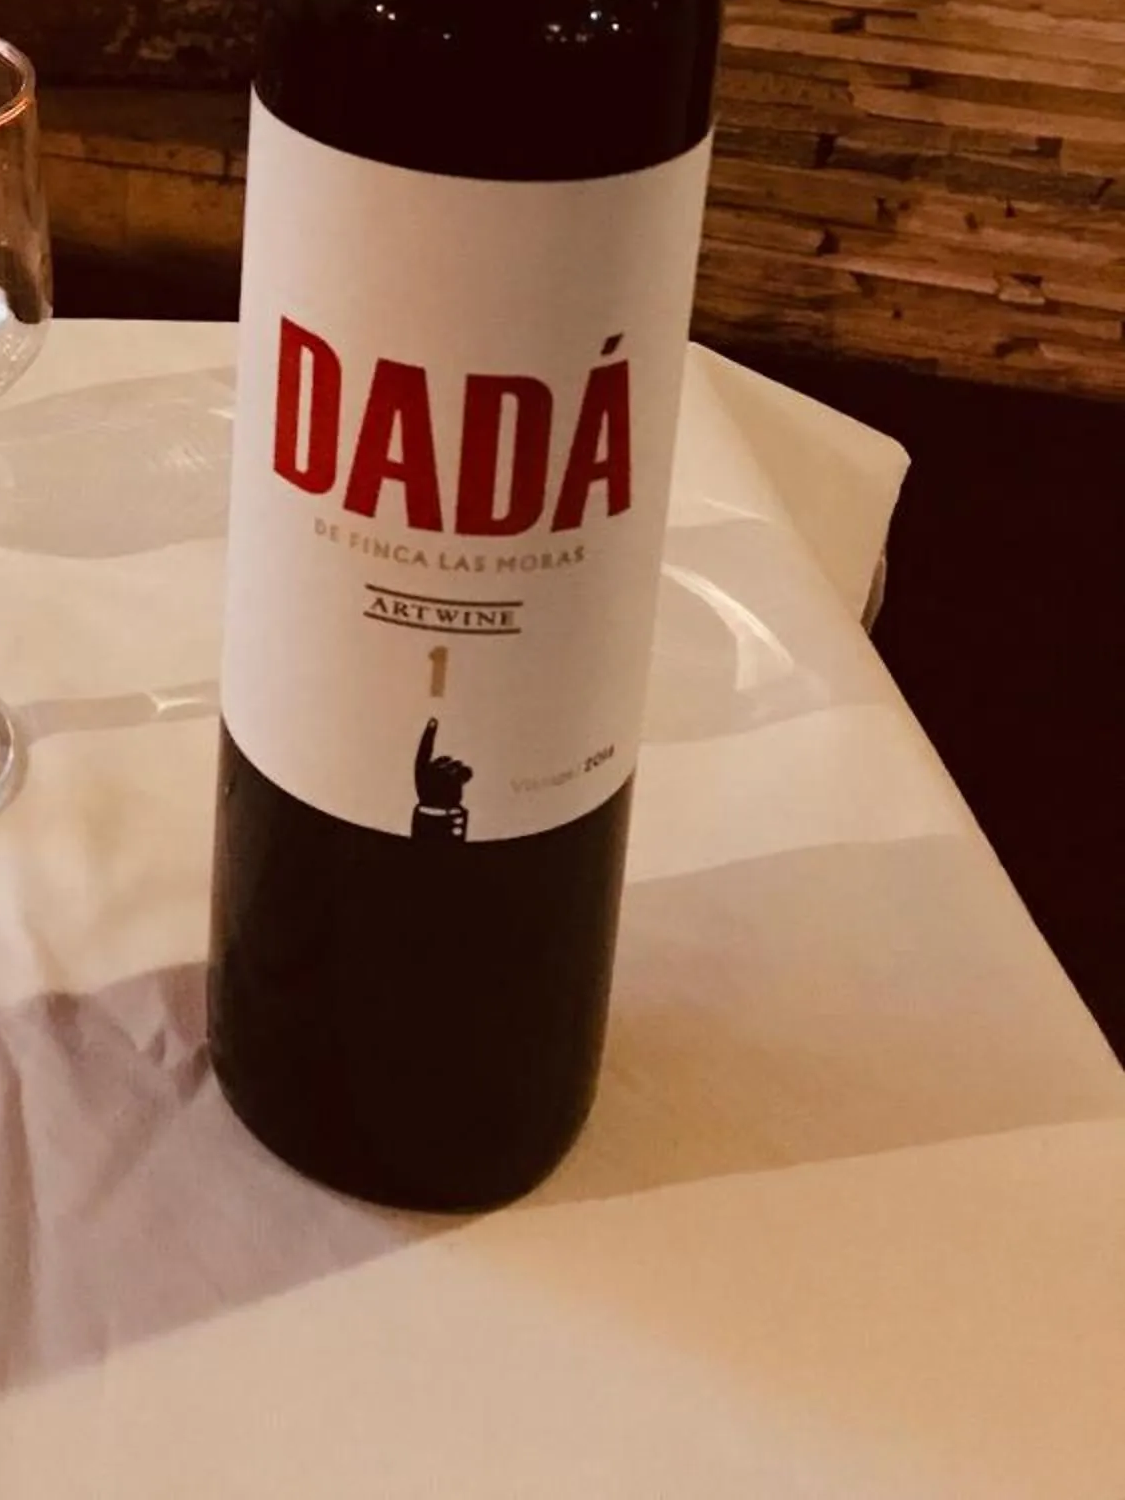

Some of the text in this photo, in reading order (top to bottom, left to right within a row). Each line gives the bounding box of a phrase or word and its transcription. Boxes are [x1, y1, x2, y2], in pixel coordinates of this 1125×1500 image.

[275, 315, 632, 537] DADÁ
[314, 518, 585, 573] DE FINCA LAS MORAS
[370, 597, 515, 626] ART WINE
[427, 646, 449, 698] 1
